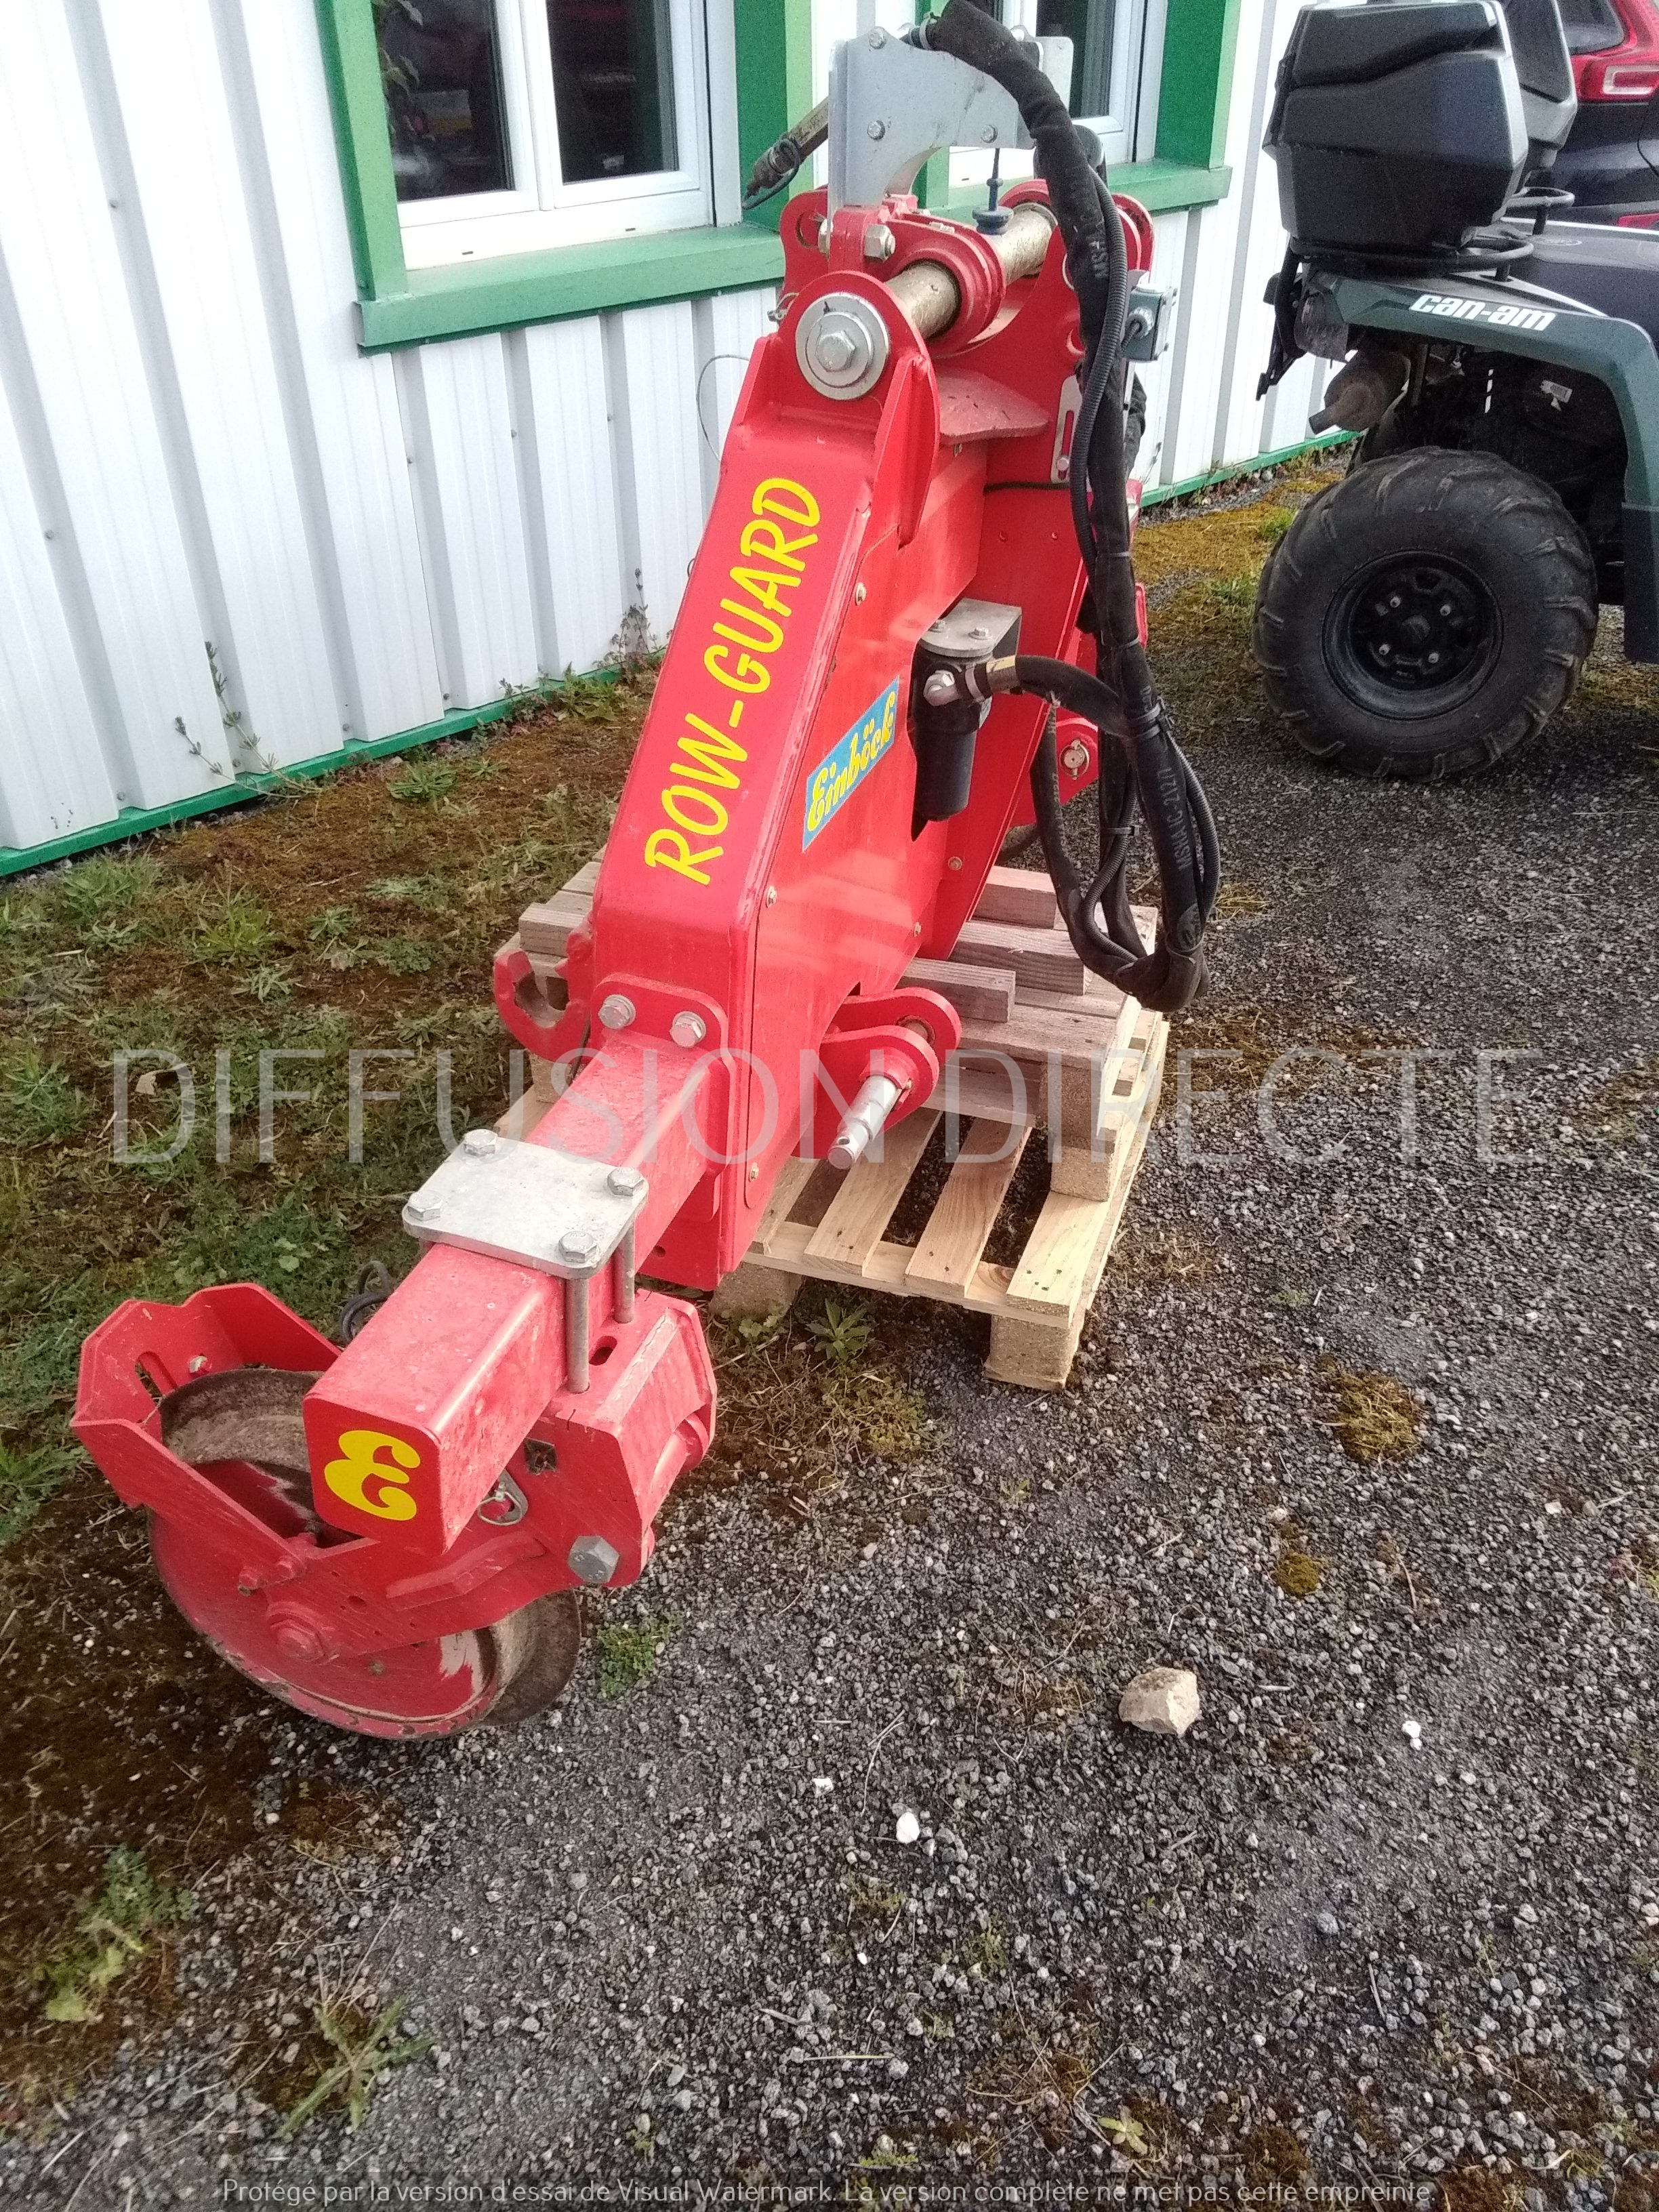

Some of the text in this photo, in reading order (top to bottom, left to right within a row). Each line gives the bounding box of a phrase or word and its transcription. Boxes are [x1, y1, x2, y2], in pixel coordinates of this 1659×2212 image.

[1408, 294, 1556, 331] can-am
[644, 476, 821, 885] ROW-GUARD
[808, 690, 896, 832] Einböck
[1170, 825, 1193, 871] MSHA
